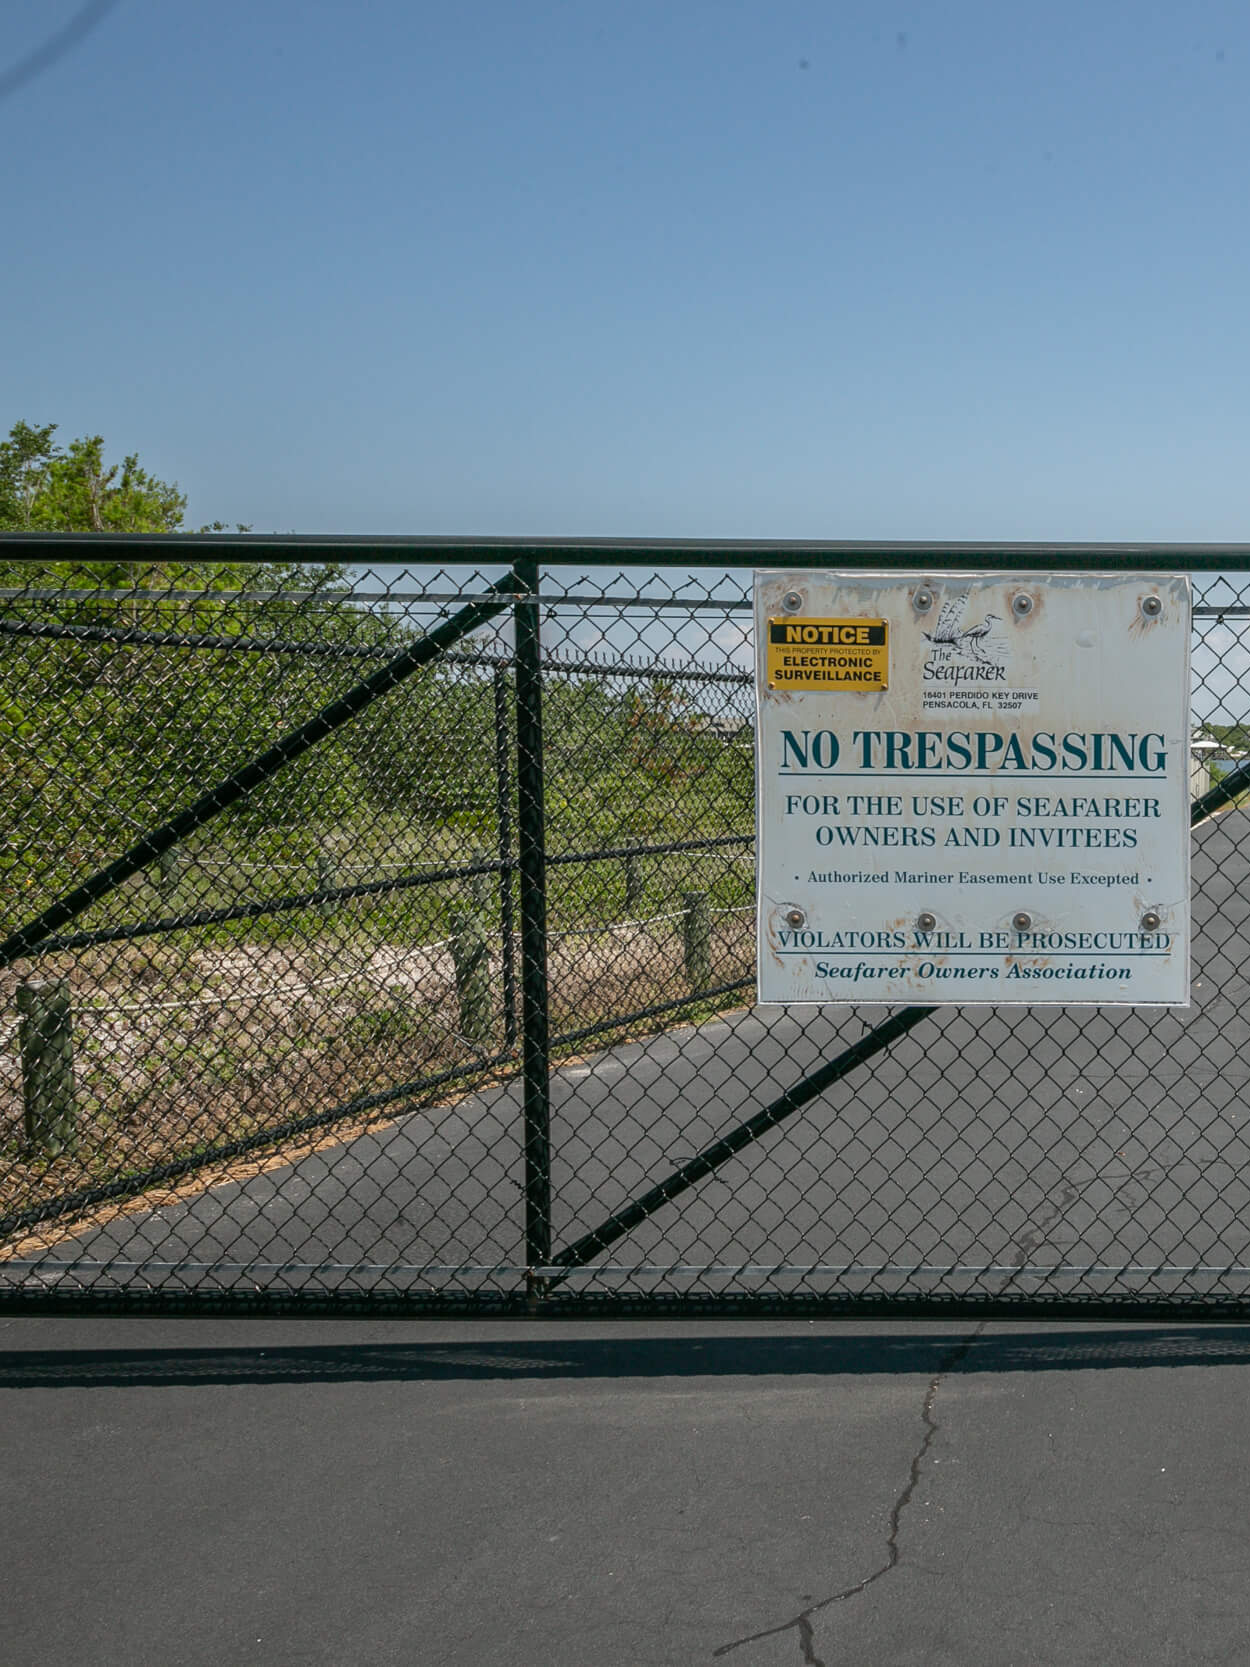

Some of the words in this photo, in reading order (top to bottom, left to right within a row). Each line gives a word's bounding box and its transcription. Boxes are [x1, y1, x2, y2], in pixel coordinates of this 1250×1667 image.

[786, 626, 870, 644] NOTICE
[783, 656, 873, 668] ELECTRONIC
[931, 648, 952, 661] The
[774, 670, 882, 682] SURVEILLANCE
[949, 692, 989, 700] PERDIDO
[992, 692, 1010, 700] KEY
[1012, 692, 1039, 700] DRIVE
[922, 701, 980, 709] PENSACOLA,
[998, 702, 1023, 710] 32507
[781, 730, 840, 770] NO
[853, 731, 1169, 772] TRESPASSING
[785, 795, 841, 817] FOR
[847, 796, 903, 817] THE
[912, 796, 963, 817] USE
[973, 796, 1009, 818] OF
[1016, 797, 1161, 819] SEAFARER
[815, 826, 936, 848] OWNERS
[944, 827, 1000, 848] AND
[1010, 828, 1138, 849] INVITEES
[807, 870, 889, 885] Authorized
[894, 871, 954, 885] Mariner
[959, 872, 1033, 885] Easement
[1037, 872, 1065, 886] Use
[1070, 872, 1139, 888] Excepted
[777, 931, 906, 949] VIOLATORS
[914, 931, 972, 949] WILL
[979, 932, 1009, 950] BE
[1016, 932, 1171, 950] PROSECUTED
[815, 961, 910, 982] Seafarer
[918, 963, 999, 981] Owners
[1005, 962, 1132, 981] Association
